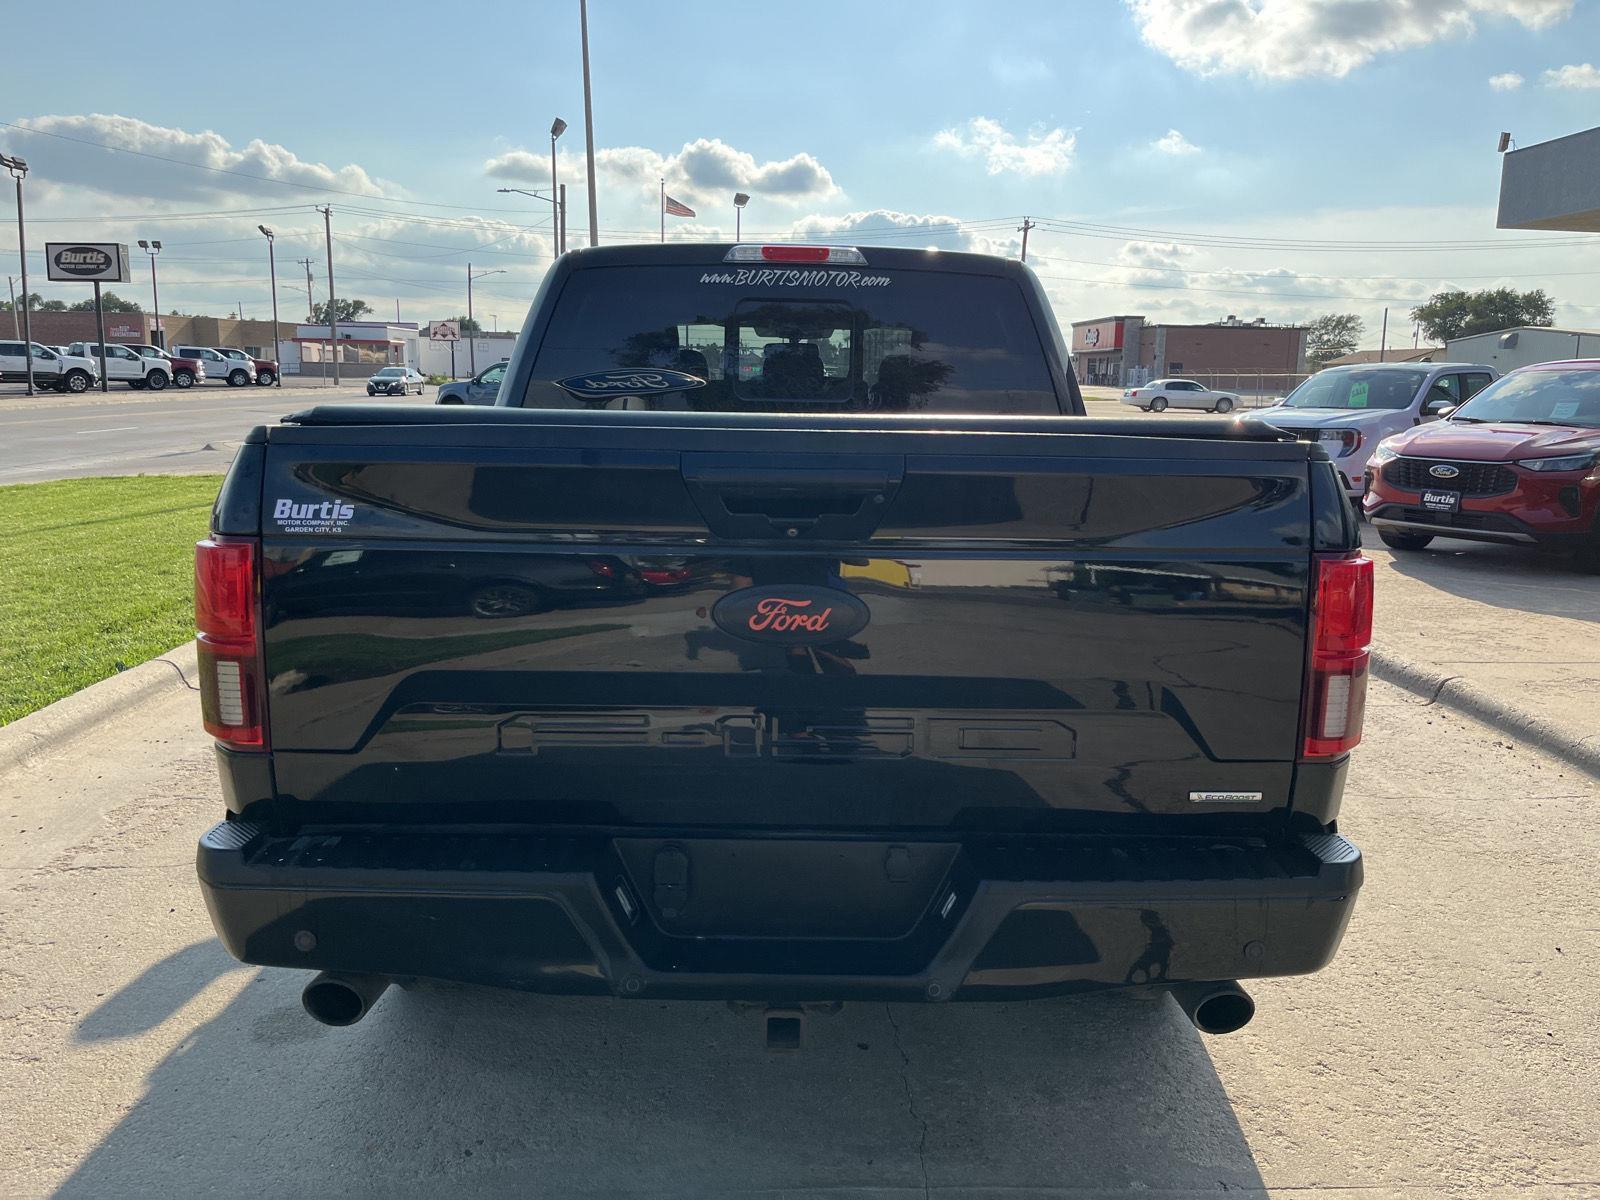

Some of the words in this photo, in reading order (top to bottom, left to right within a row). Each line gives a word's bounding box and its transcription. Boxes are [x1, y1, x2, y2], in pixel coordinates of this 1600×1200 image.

[60, 251, 106, 264] Burtis
[699, 269, 892, 289] www.BURTISMOTOR.com
[1423, 493, 1455, 504] Burtis
[273, 499, 355, 519] Burtis
[748, 598, 832, 632] Ford
